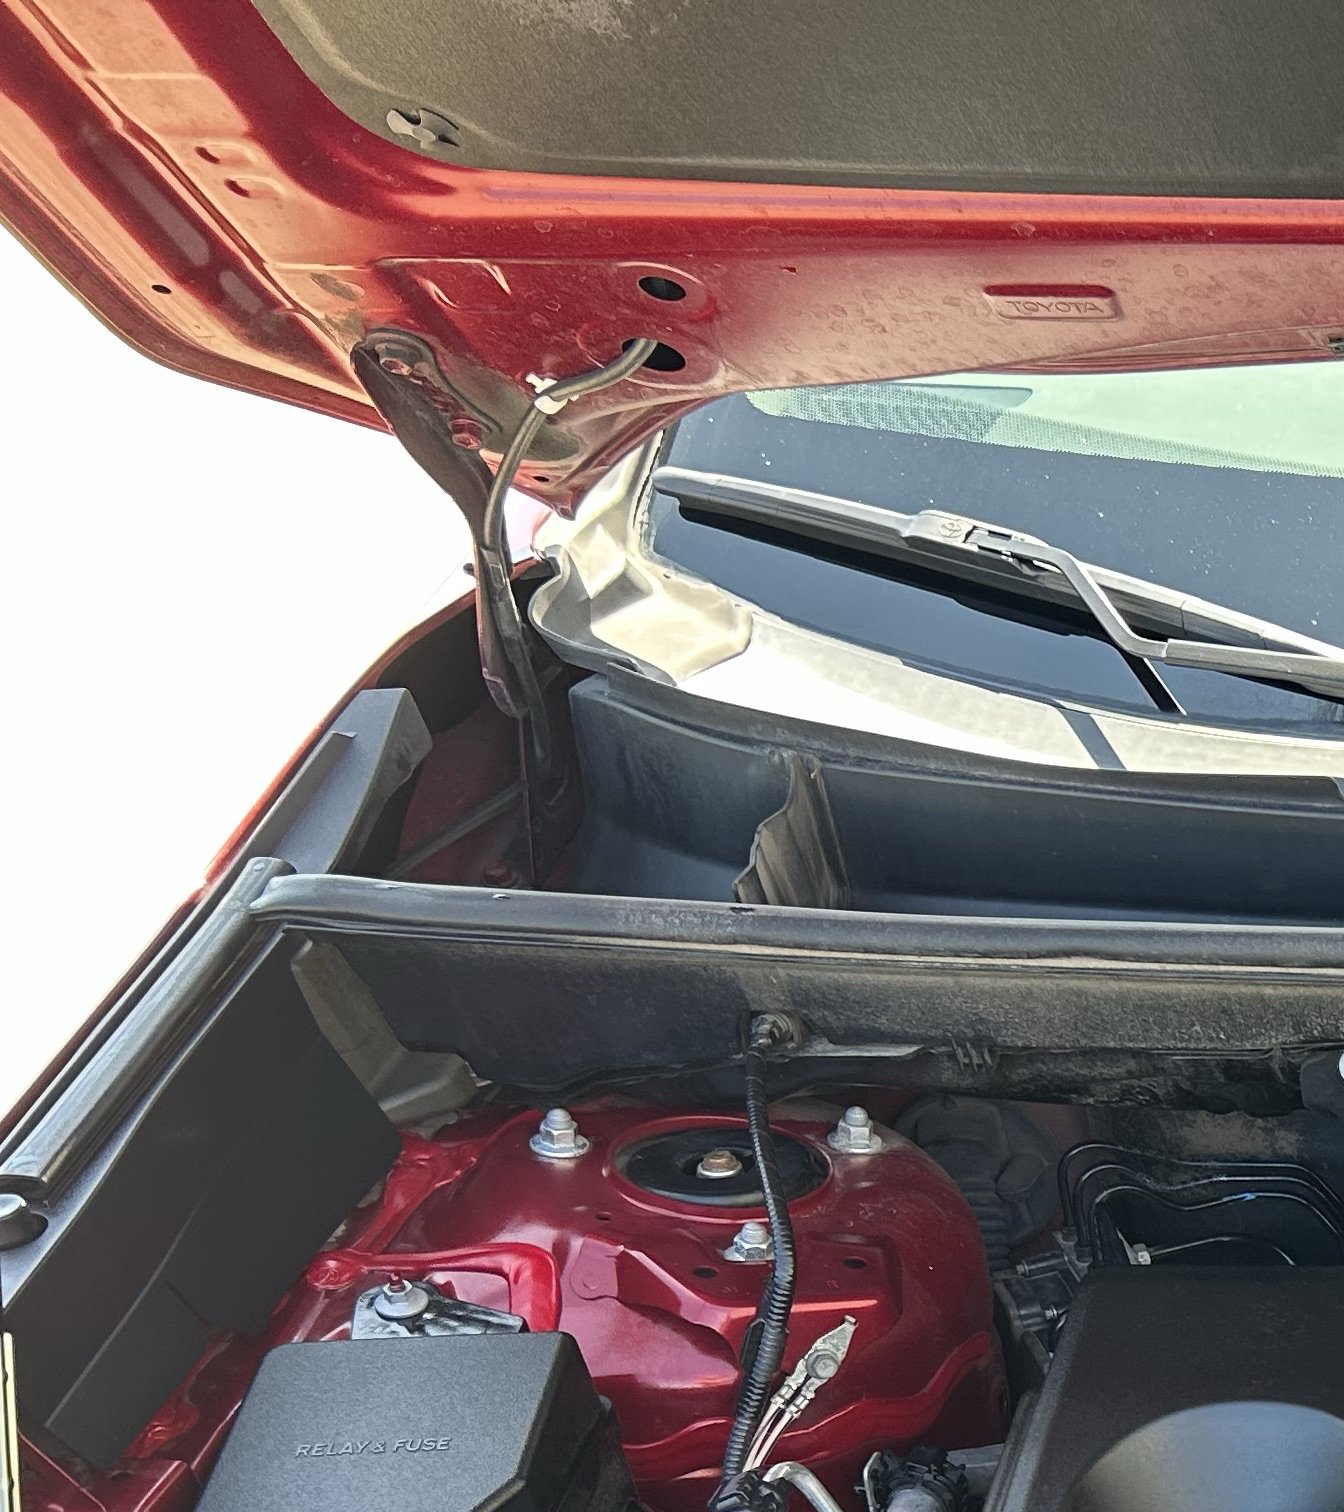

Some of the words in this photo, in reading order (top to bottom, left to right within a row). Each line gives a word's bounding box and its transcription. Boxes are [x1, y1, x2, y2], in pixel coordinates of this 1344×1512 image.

[1005, 300, 1104, 314] TOYOTA
[295, 1440, 371, 1457] RELAY
[370, 1440, 386, 1454] &
[391, 1436, 454, 1453] FUSE
